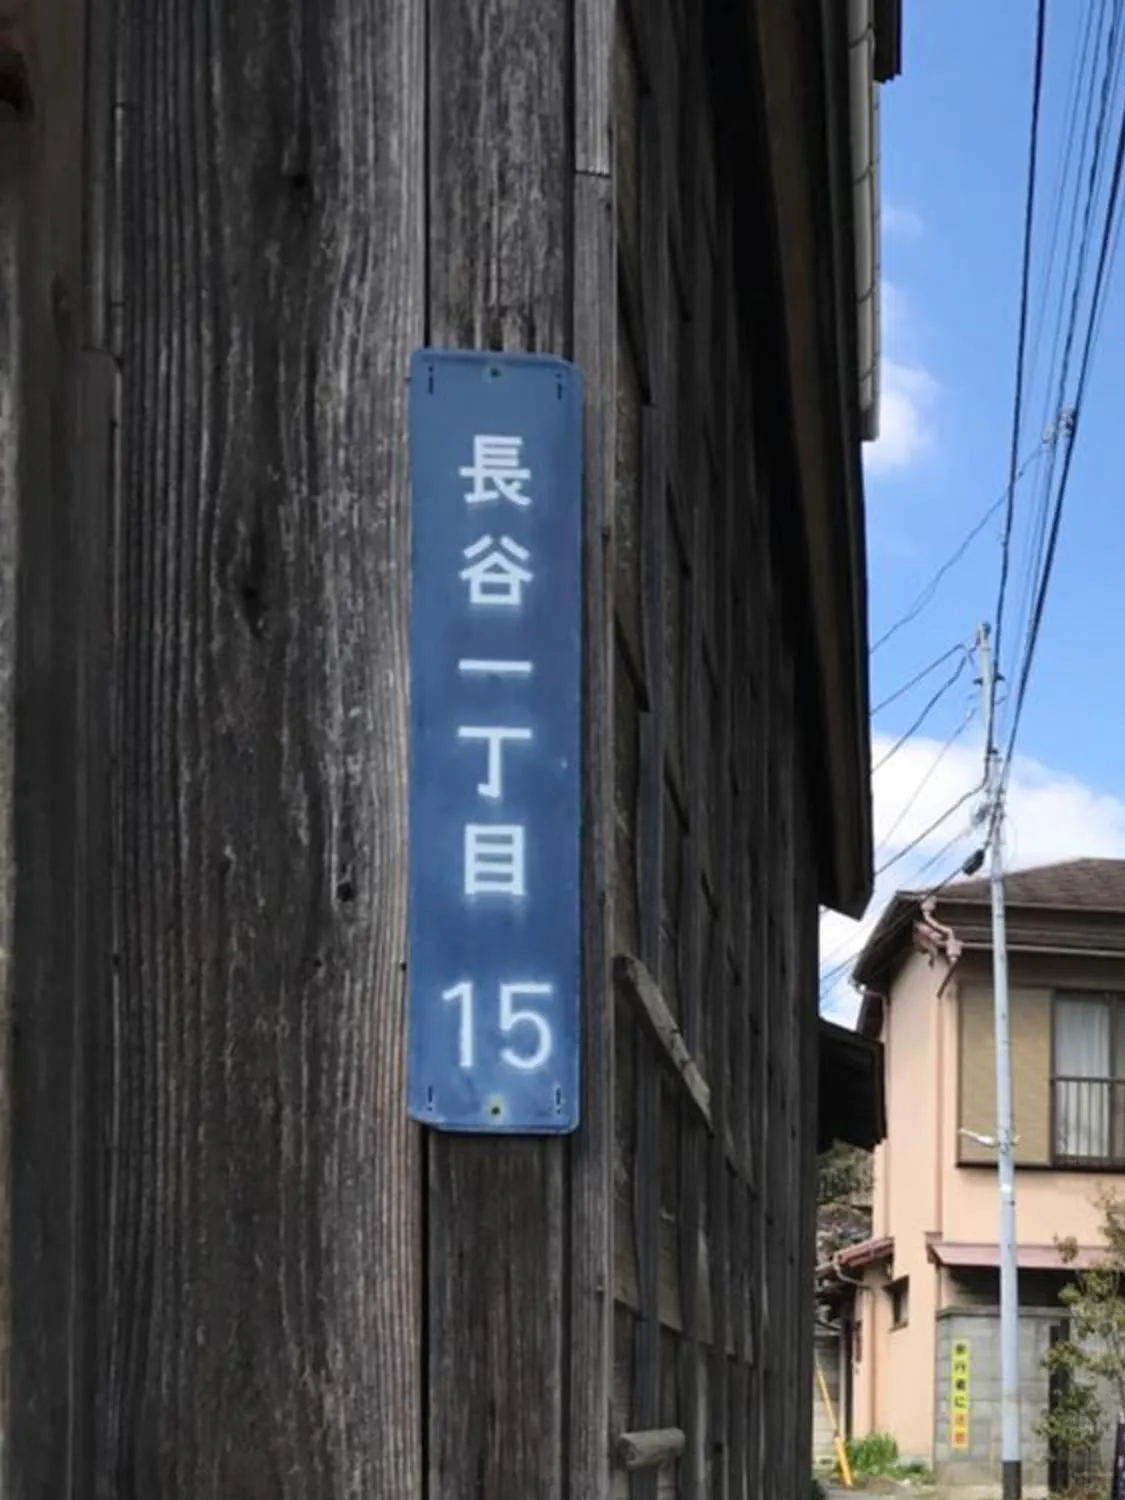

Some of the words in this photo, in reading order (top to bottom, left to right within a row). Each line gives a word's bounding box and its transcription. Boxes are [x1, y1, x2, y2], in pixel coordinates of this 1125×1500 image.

[459, 435, 532, 897] 長谷一丁目
[443, 982, 551, 1070] 15
